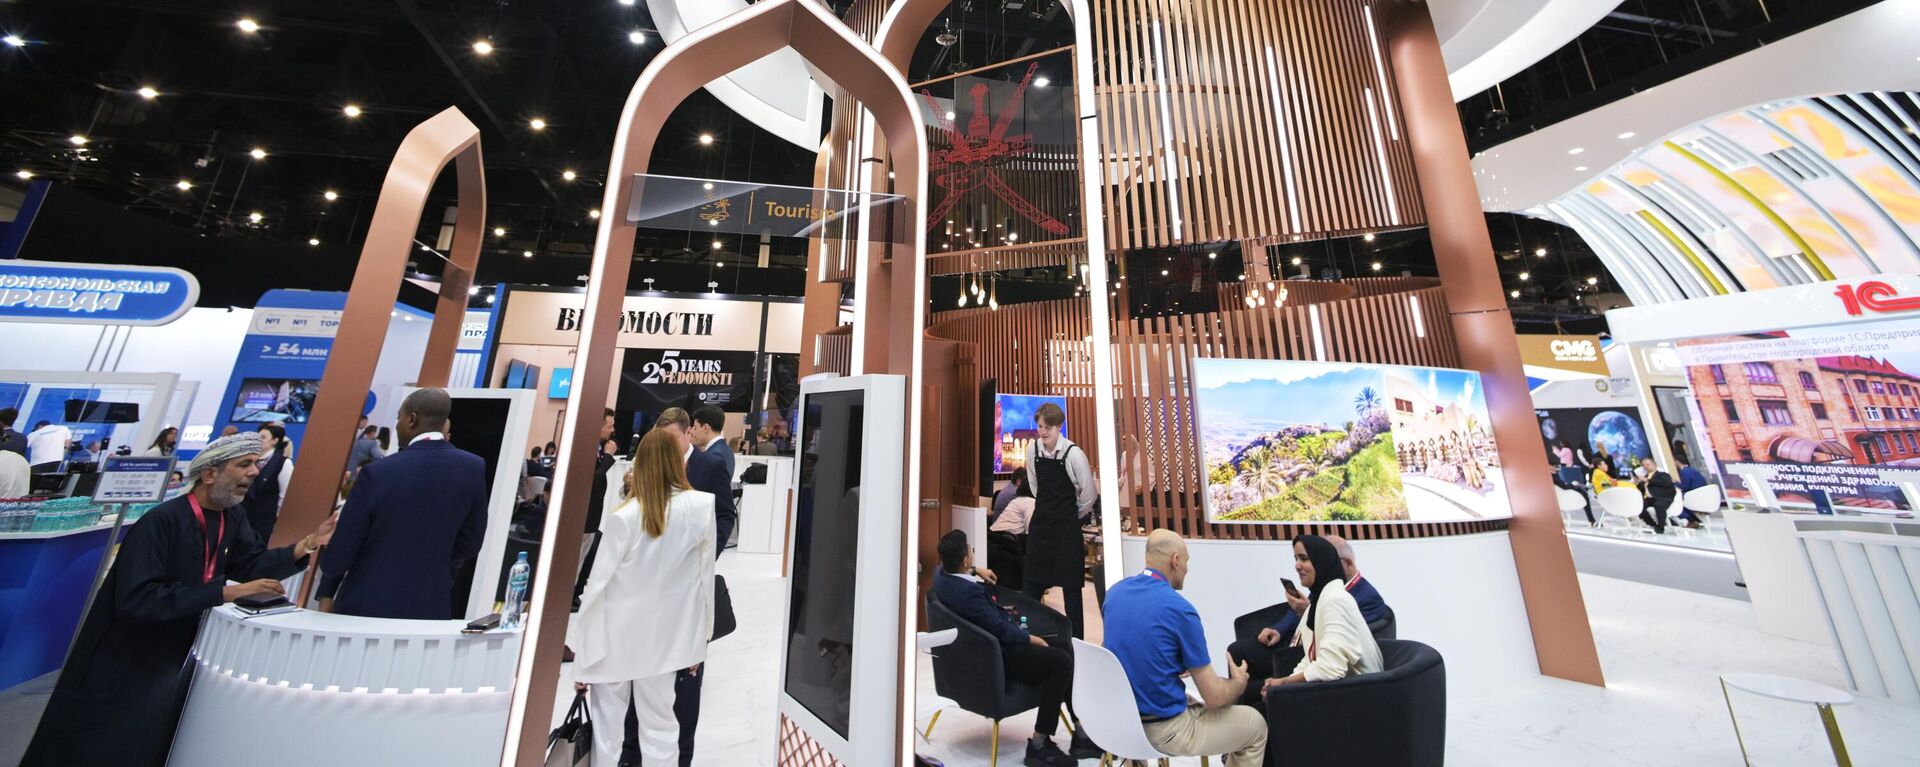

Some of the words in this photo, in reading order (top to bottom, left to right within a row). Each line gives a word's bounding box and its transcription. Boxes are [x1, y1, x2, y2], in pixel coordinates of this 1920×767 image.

[765, 201, 836, 220] Tourism
[556, 307, 715, 336] ВМОСТИ
[277, 343, 300, 355] 54
[1550, 340, 1596, 357] CMG
[1844, 343, 1890, 353] области
[640, 350, 681, 384] 25
[680, 358, 722, 373] YEARS
[662, 371, 733, 386] VEDOMOSTI
[1801, 465, 1878, 476] ПОДКЛЮЧЕНИЯ
[1777, 473, 1840, 484] УЧРЕЖДЕНИЙ
